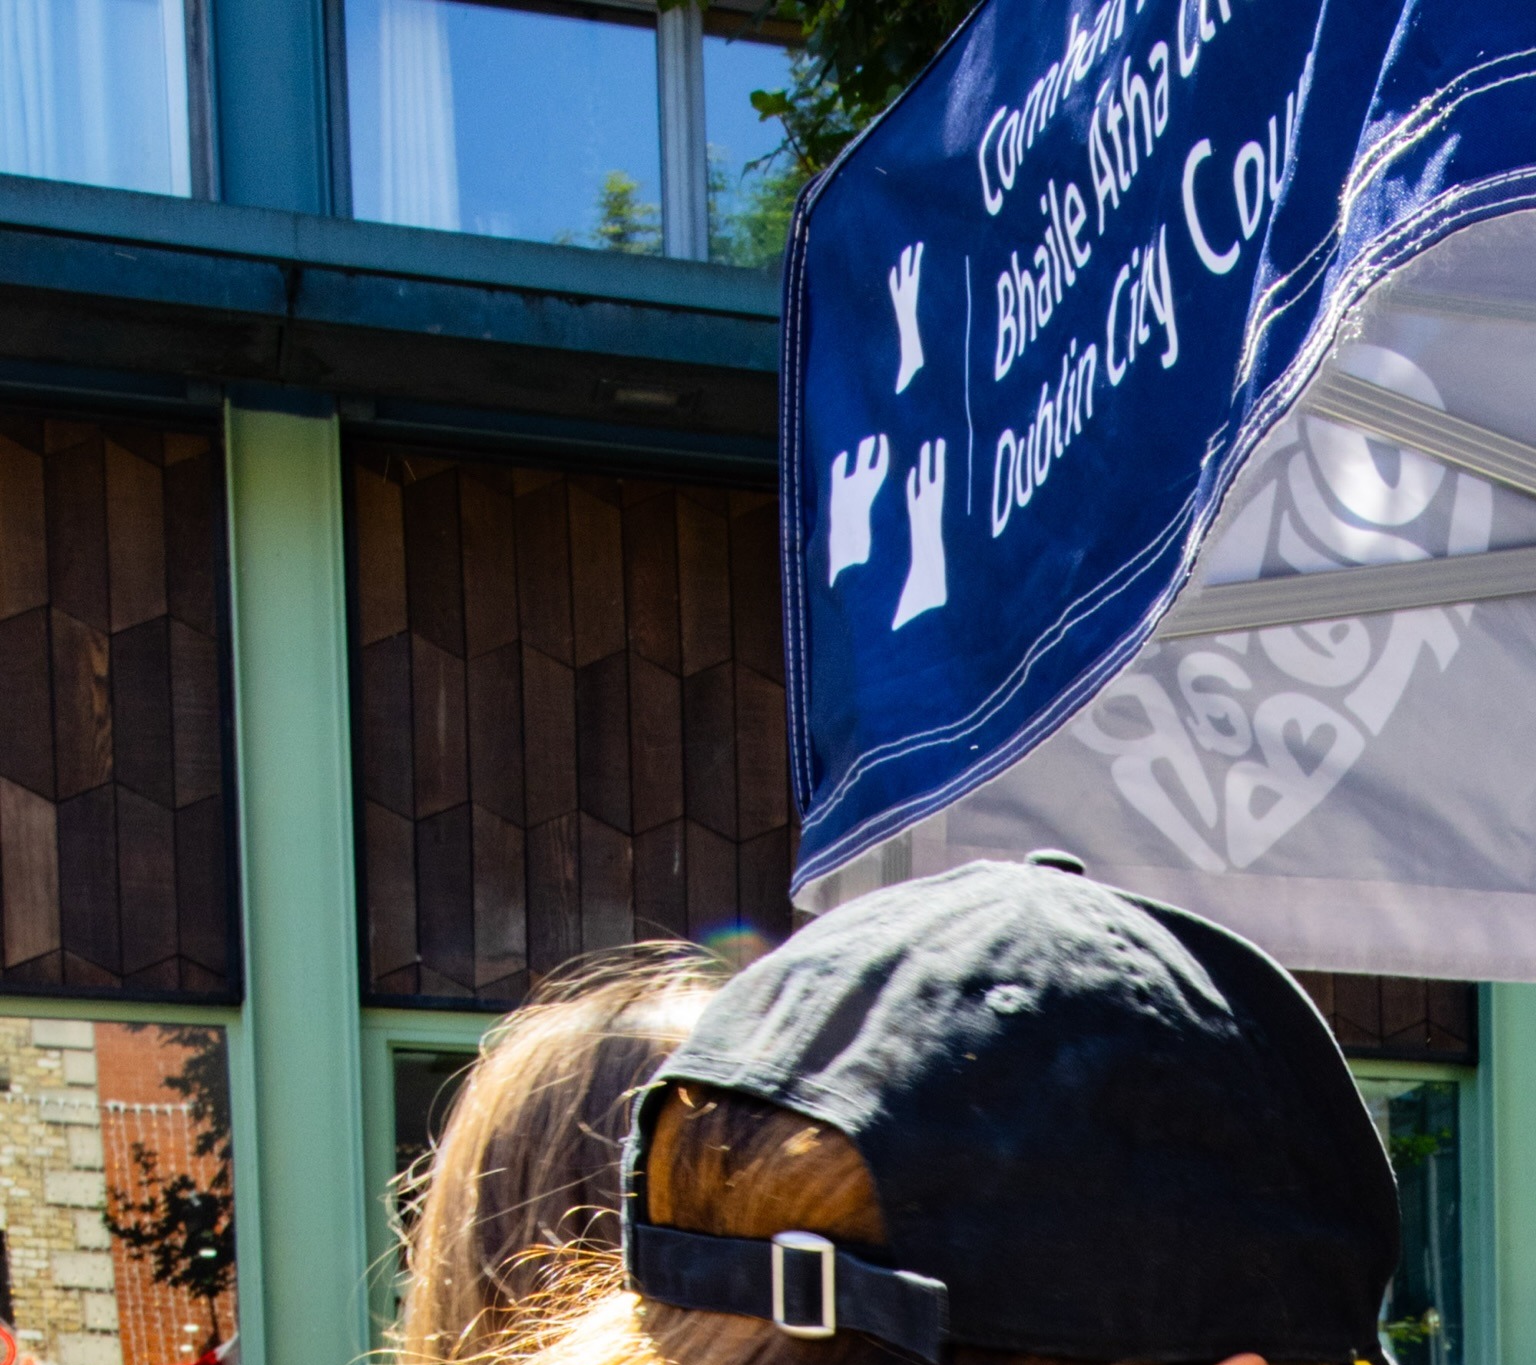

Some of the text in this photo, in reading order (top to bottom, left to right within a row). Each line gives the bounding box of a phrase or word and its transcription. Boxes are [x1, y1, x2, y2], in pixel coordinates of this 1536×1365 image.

[992, 337, 1097, 538] Dublin
[1106, 223, 1178, 386] City
[995, 178, 1091, 380] Bhaile
